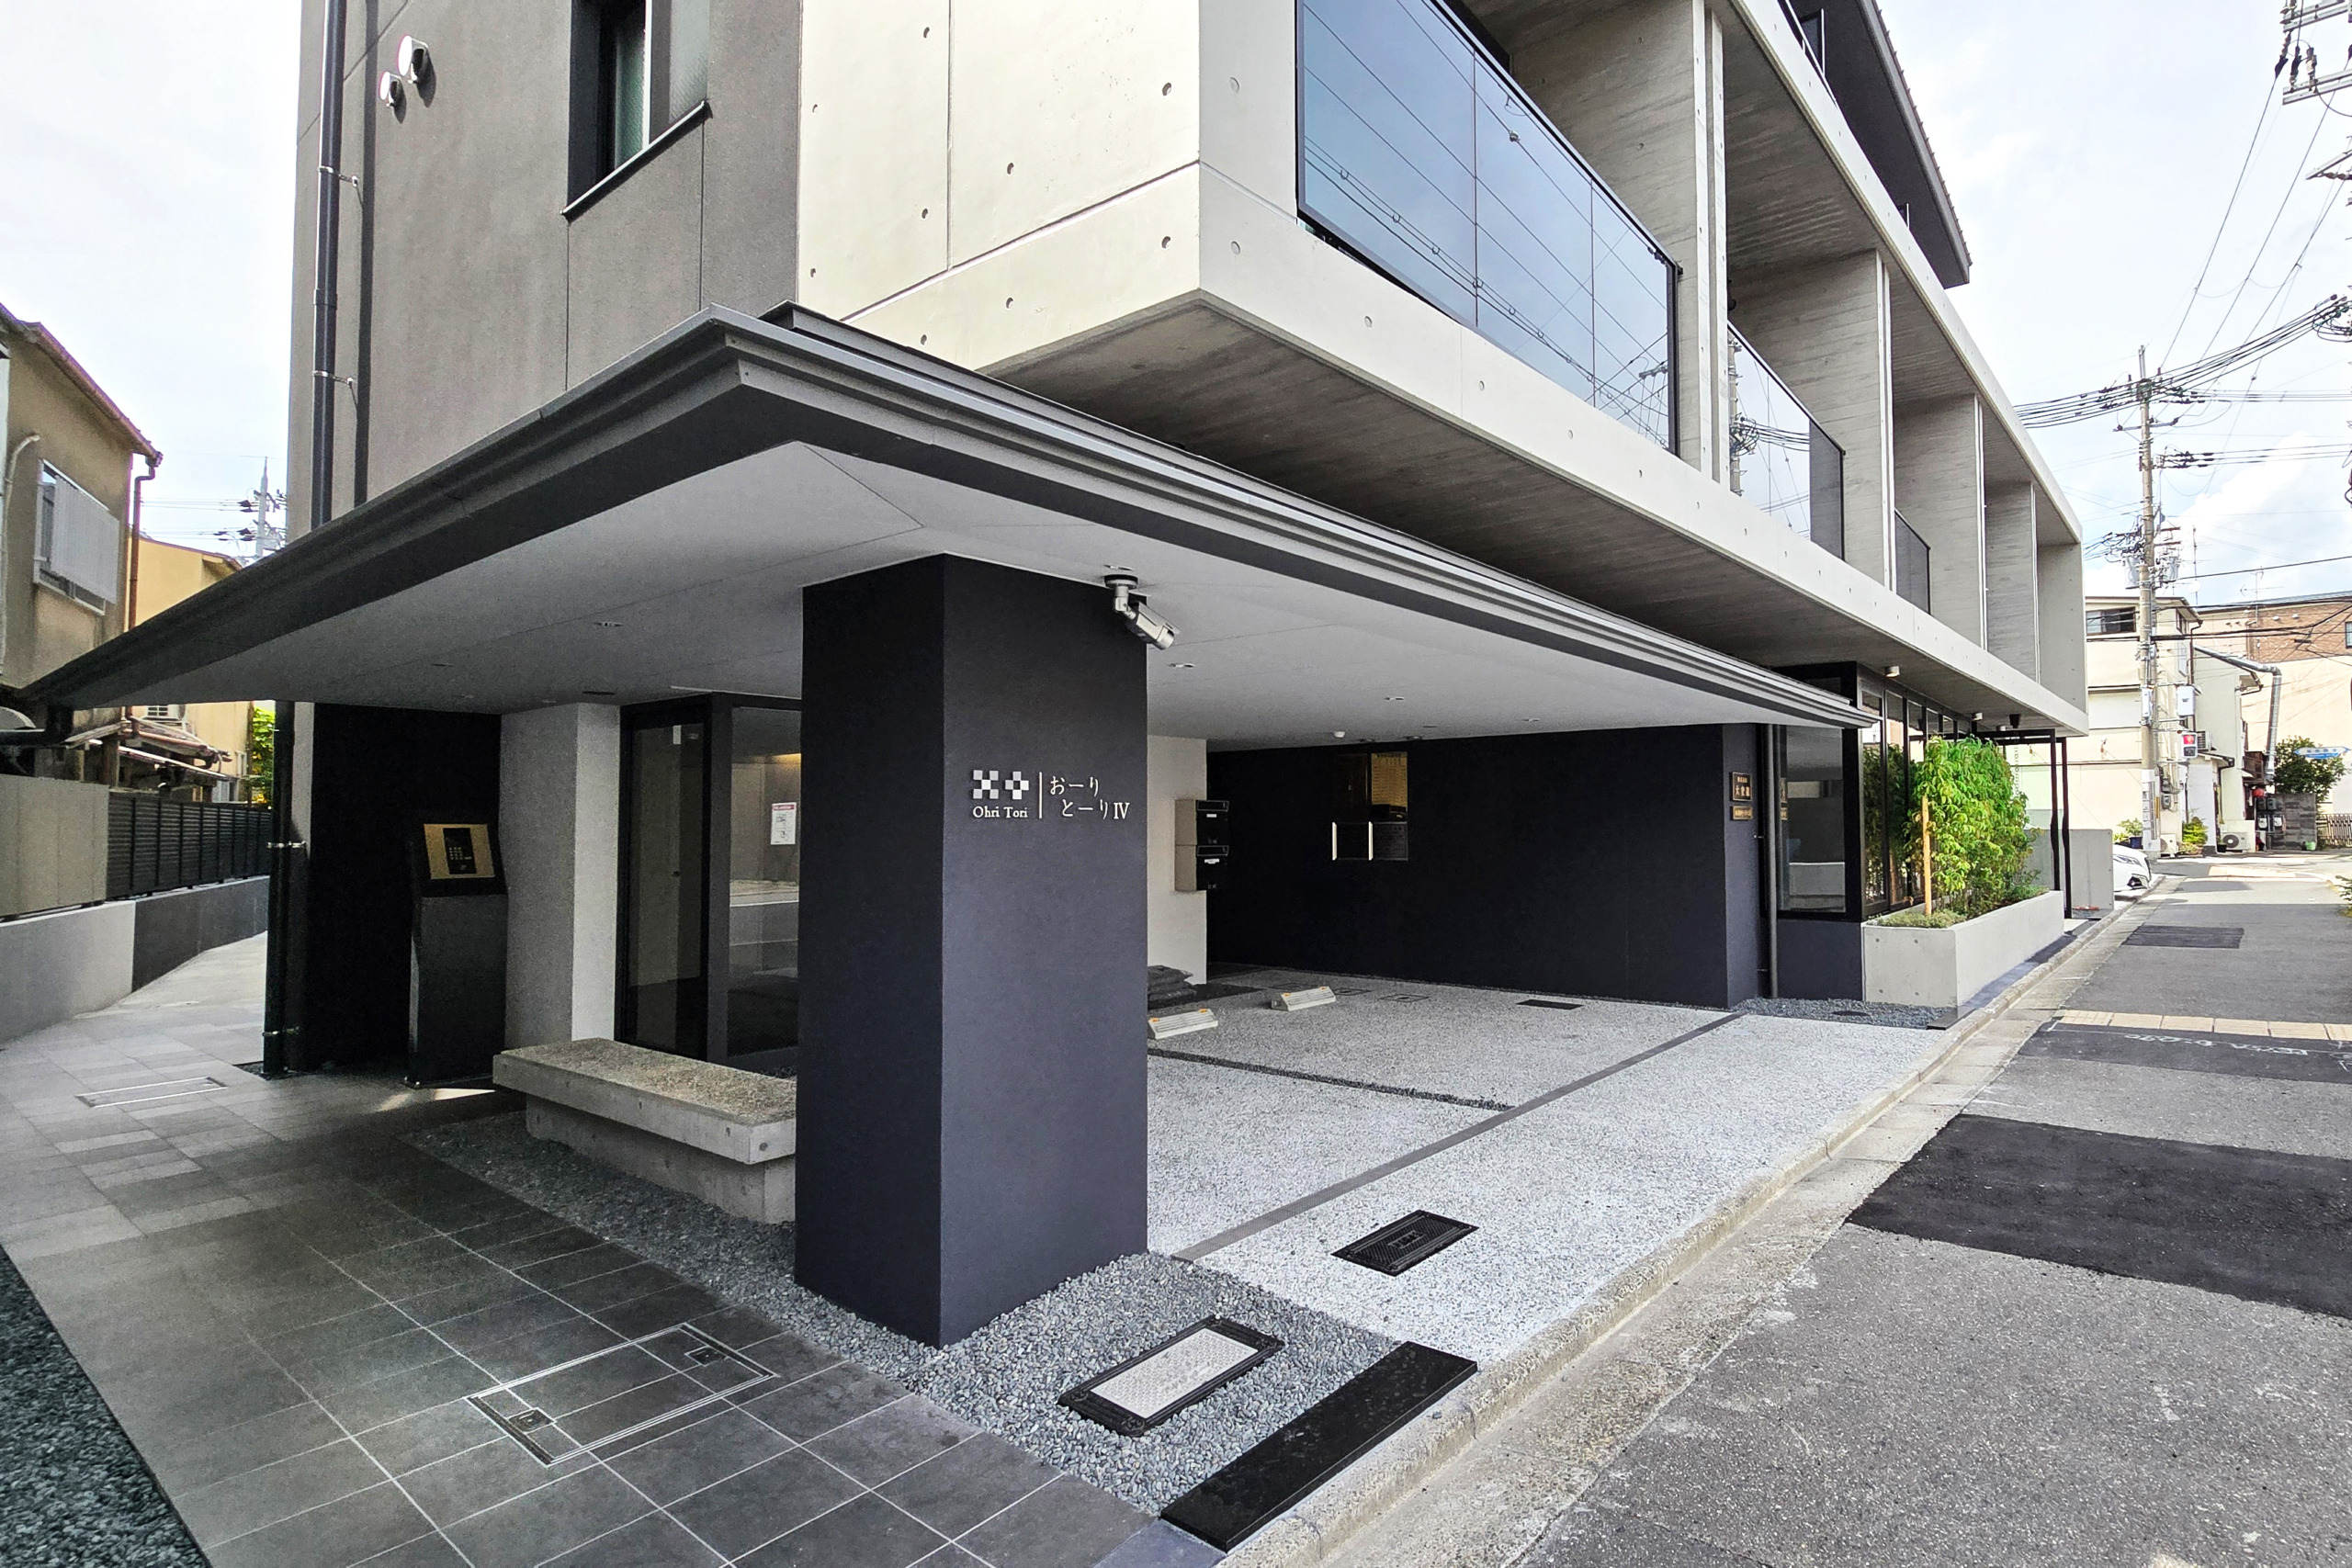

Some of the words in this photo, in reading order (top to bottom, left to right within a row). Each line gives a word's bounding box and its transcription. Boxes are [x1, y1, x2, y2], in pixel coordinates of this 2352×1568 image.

[1049, 775, 1099, 797] おーり
[972, 805, 1001, 818] Ohri
[1003, 806, 1028, 818] Tori
